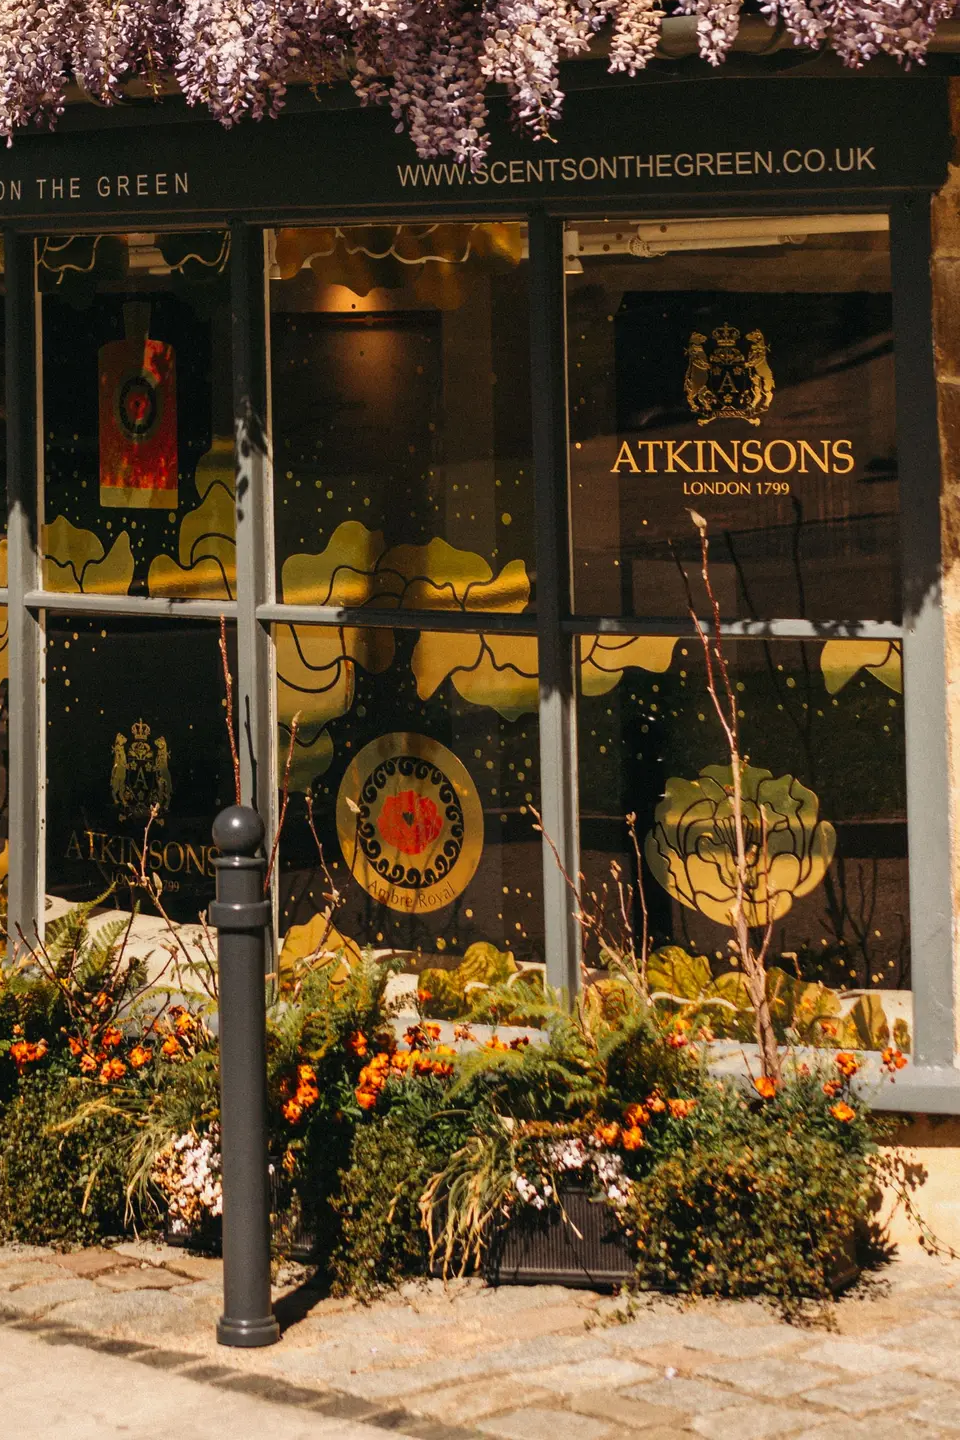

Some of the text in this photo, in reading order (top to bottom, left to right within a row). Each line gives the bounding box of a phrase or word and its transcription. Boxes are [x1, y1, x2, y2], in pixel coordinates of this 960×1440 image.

[396, 146, 877, 188] WWW.SCENTSONTHEGREEN.CO.UK
[35, 176, 81, 199] THE
[96, 170, 190, 197] GREEN
[718, 371, 739, 393] A
[610, 439, 855, 474] ATKINSONS
[682, 481, 791, 496] LONDON 1799
[367, 880, 455, 908] Ambre Royal
